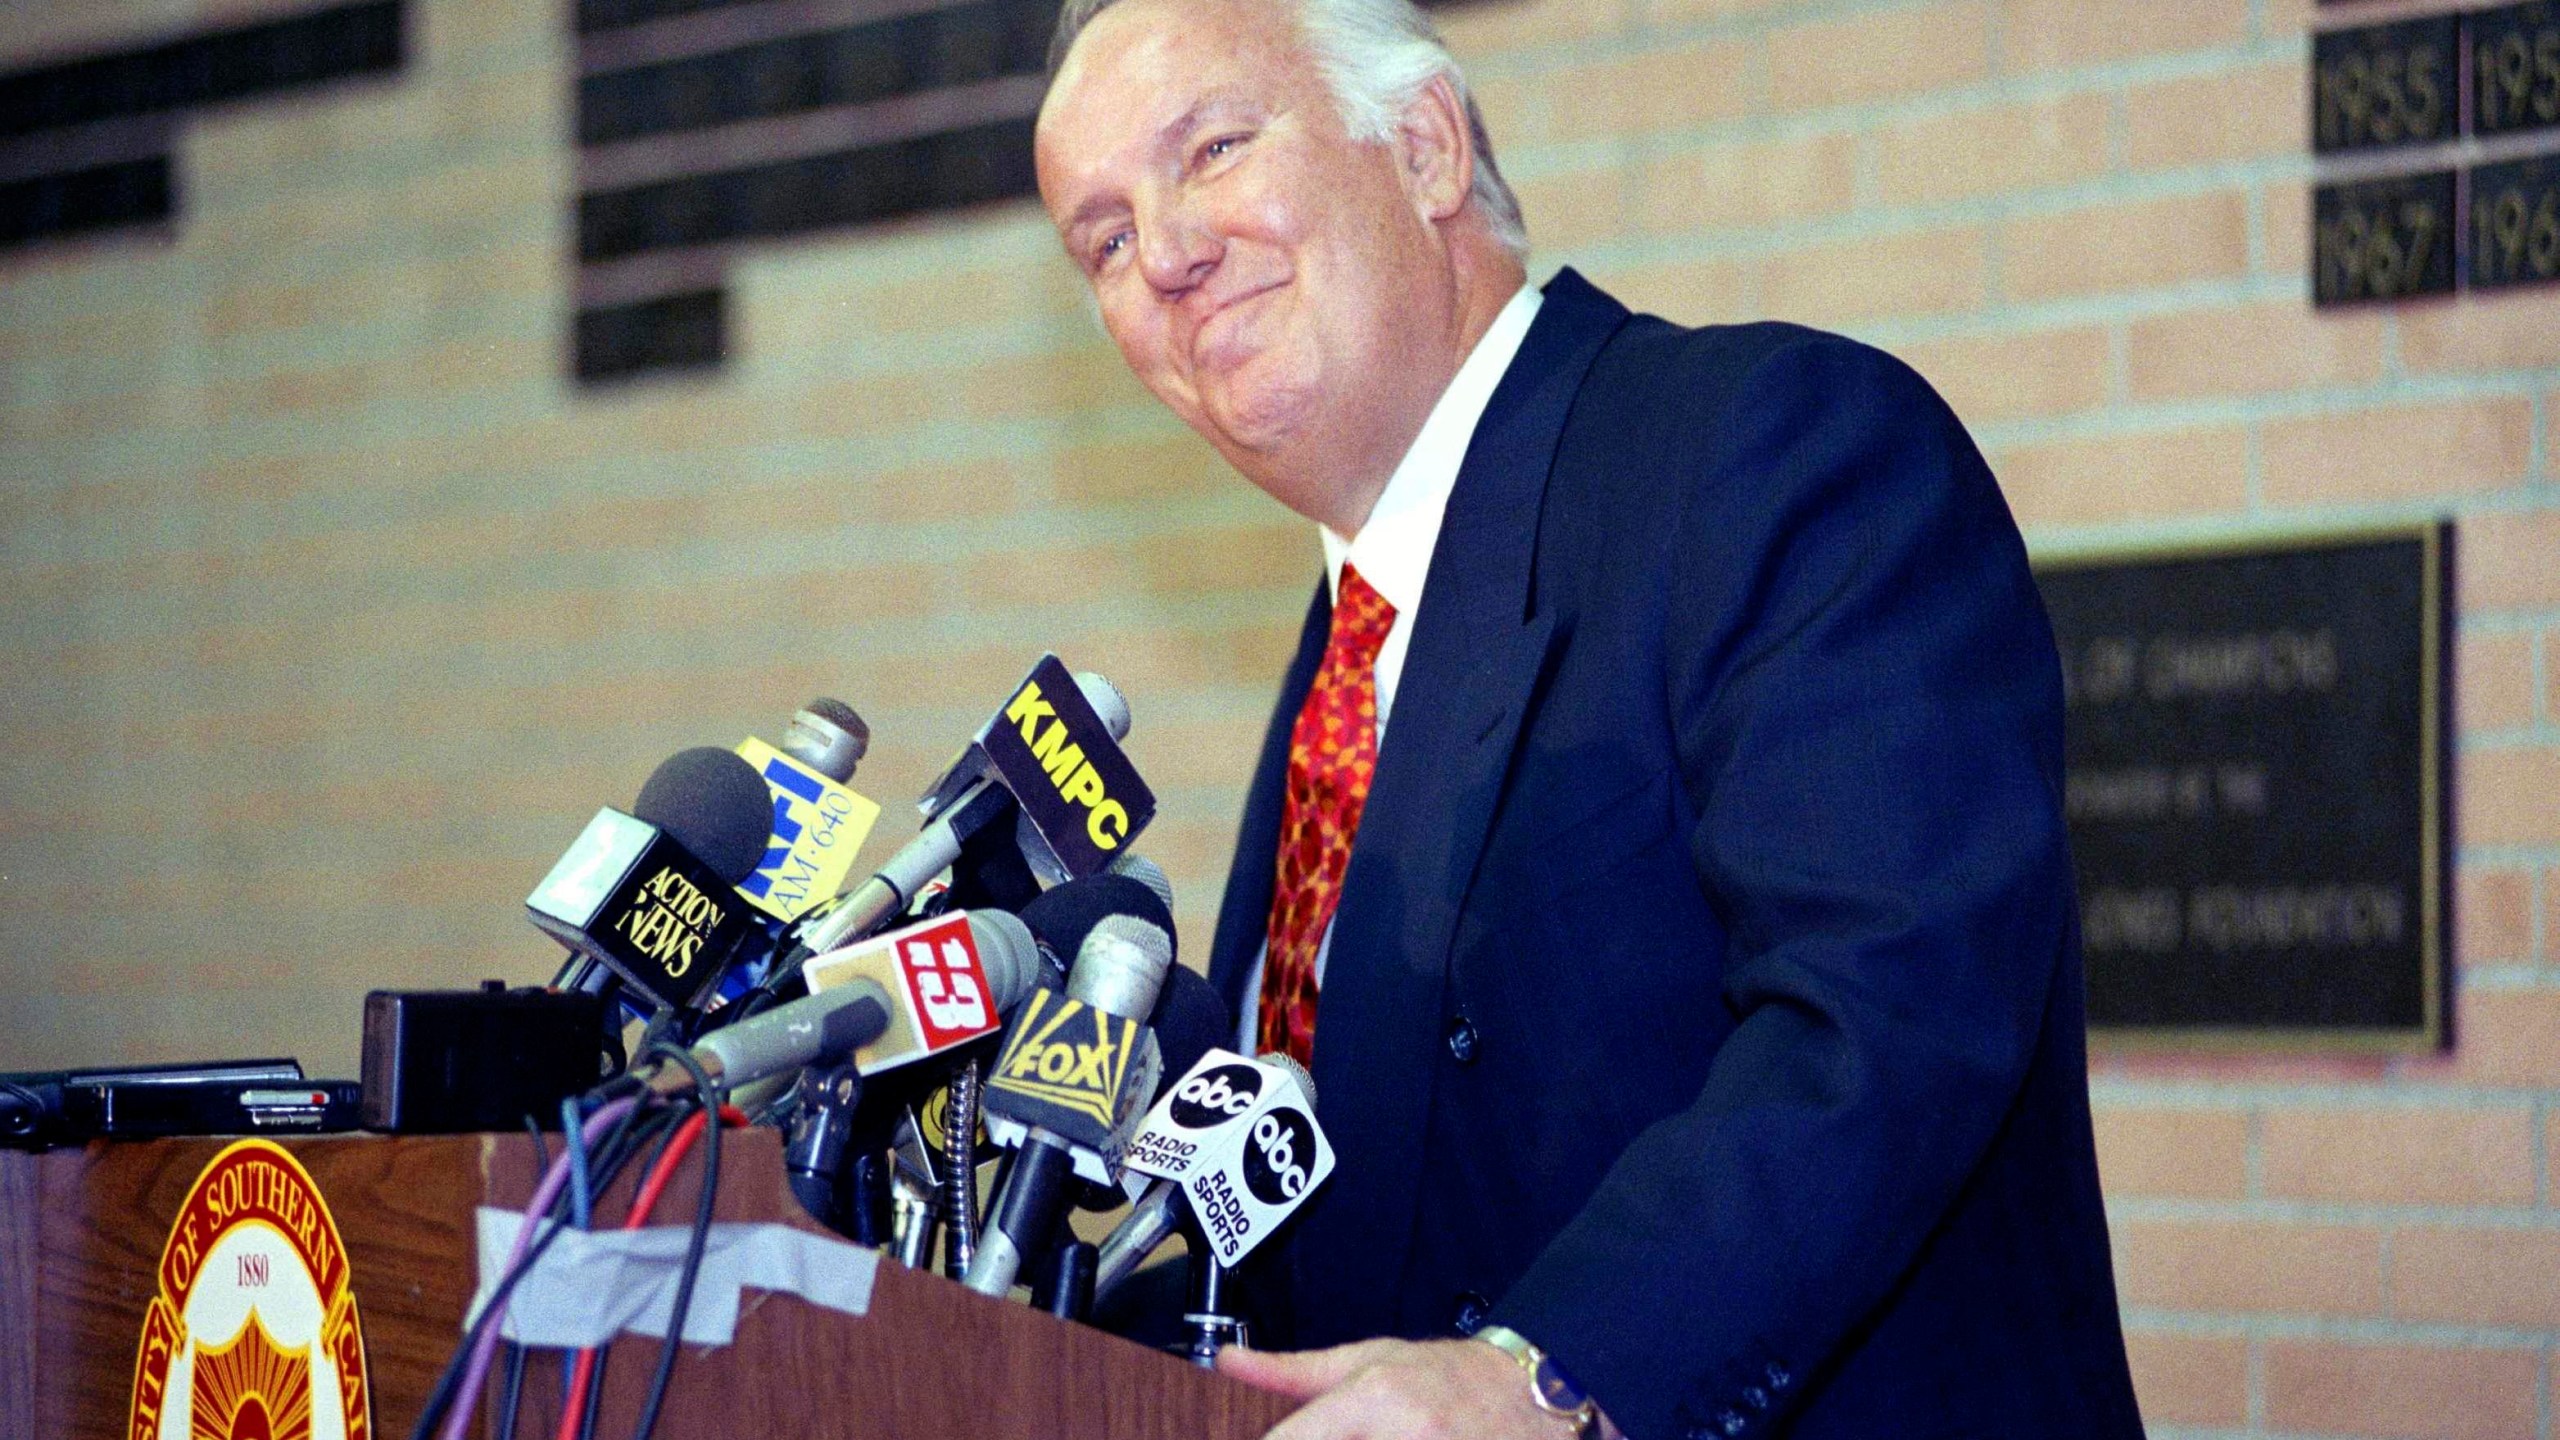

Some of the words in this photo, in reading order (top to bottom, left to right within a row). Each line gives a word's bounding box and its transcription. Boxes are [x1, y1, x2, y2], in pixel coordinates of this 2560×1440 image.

[2319, 200, 2436, 300] 1967
[1005, 680, 1129, 850] KMPC
[614, 889, 705, 978] NEWS
[643, 866, 726, 931] ACTION
[1010, 1042, 1117, 1089] FOX
[1178, 1074, 1255, 1115] abc
[1138, 1131, 1198, 1157] RADIO
[1254, 1114, 1306, 1198] abc
[171, 1212, 201, 1292] OF
[207, 1160, 336, 1286] SOUTHERN
[1193, 1175, 1240, 1257] SPORTS
[1211, 1168, 1251, 1236] RADIO
[236, 1254, 270, 1288] 1880
